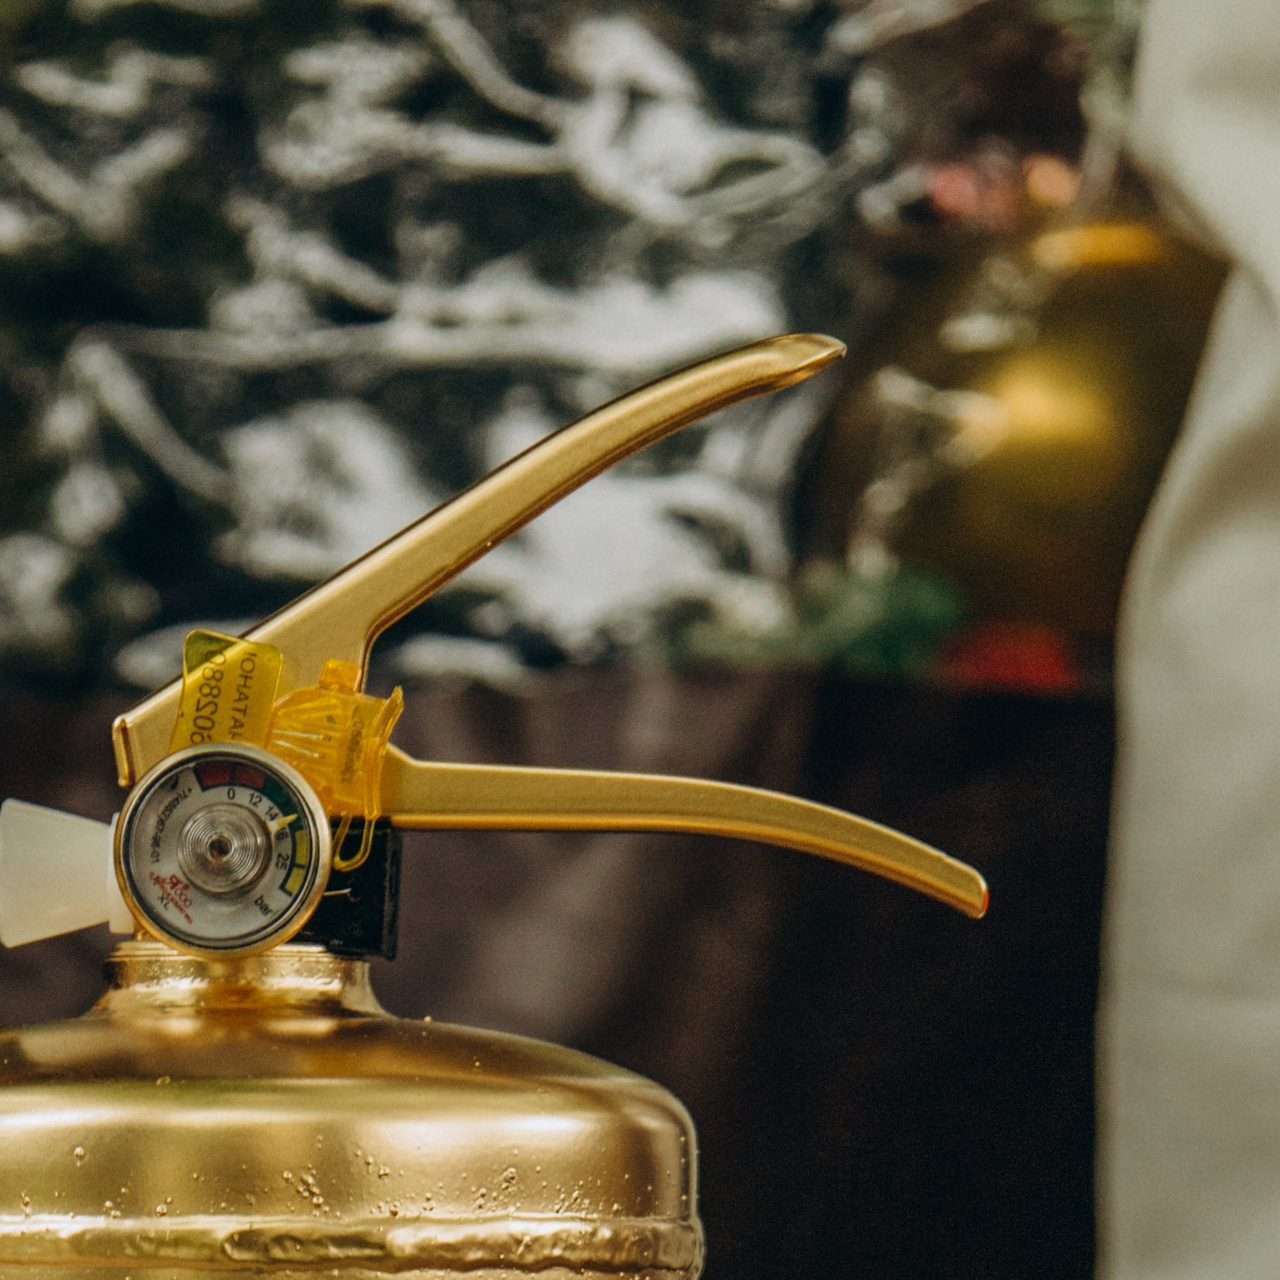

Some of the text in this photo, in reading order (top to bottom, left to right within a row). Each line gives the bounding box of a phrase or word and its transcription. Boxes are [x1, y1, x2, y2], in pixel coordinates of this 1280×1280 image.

[227, 788, 236, 800] 0
[249, 792, 263, 806] 12
[275, 853, 290, 871] 25
[254, 896, 274, 917] bar
